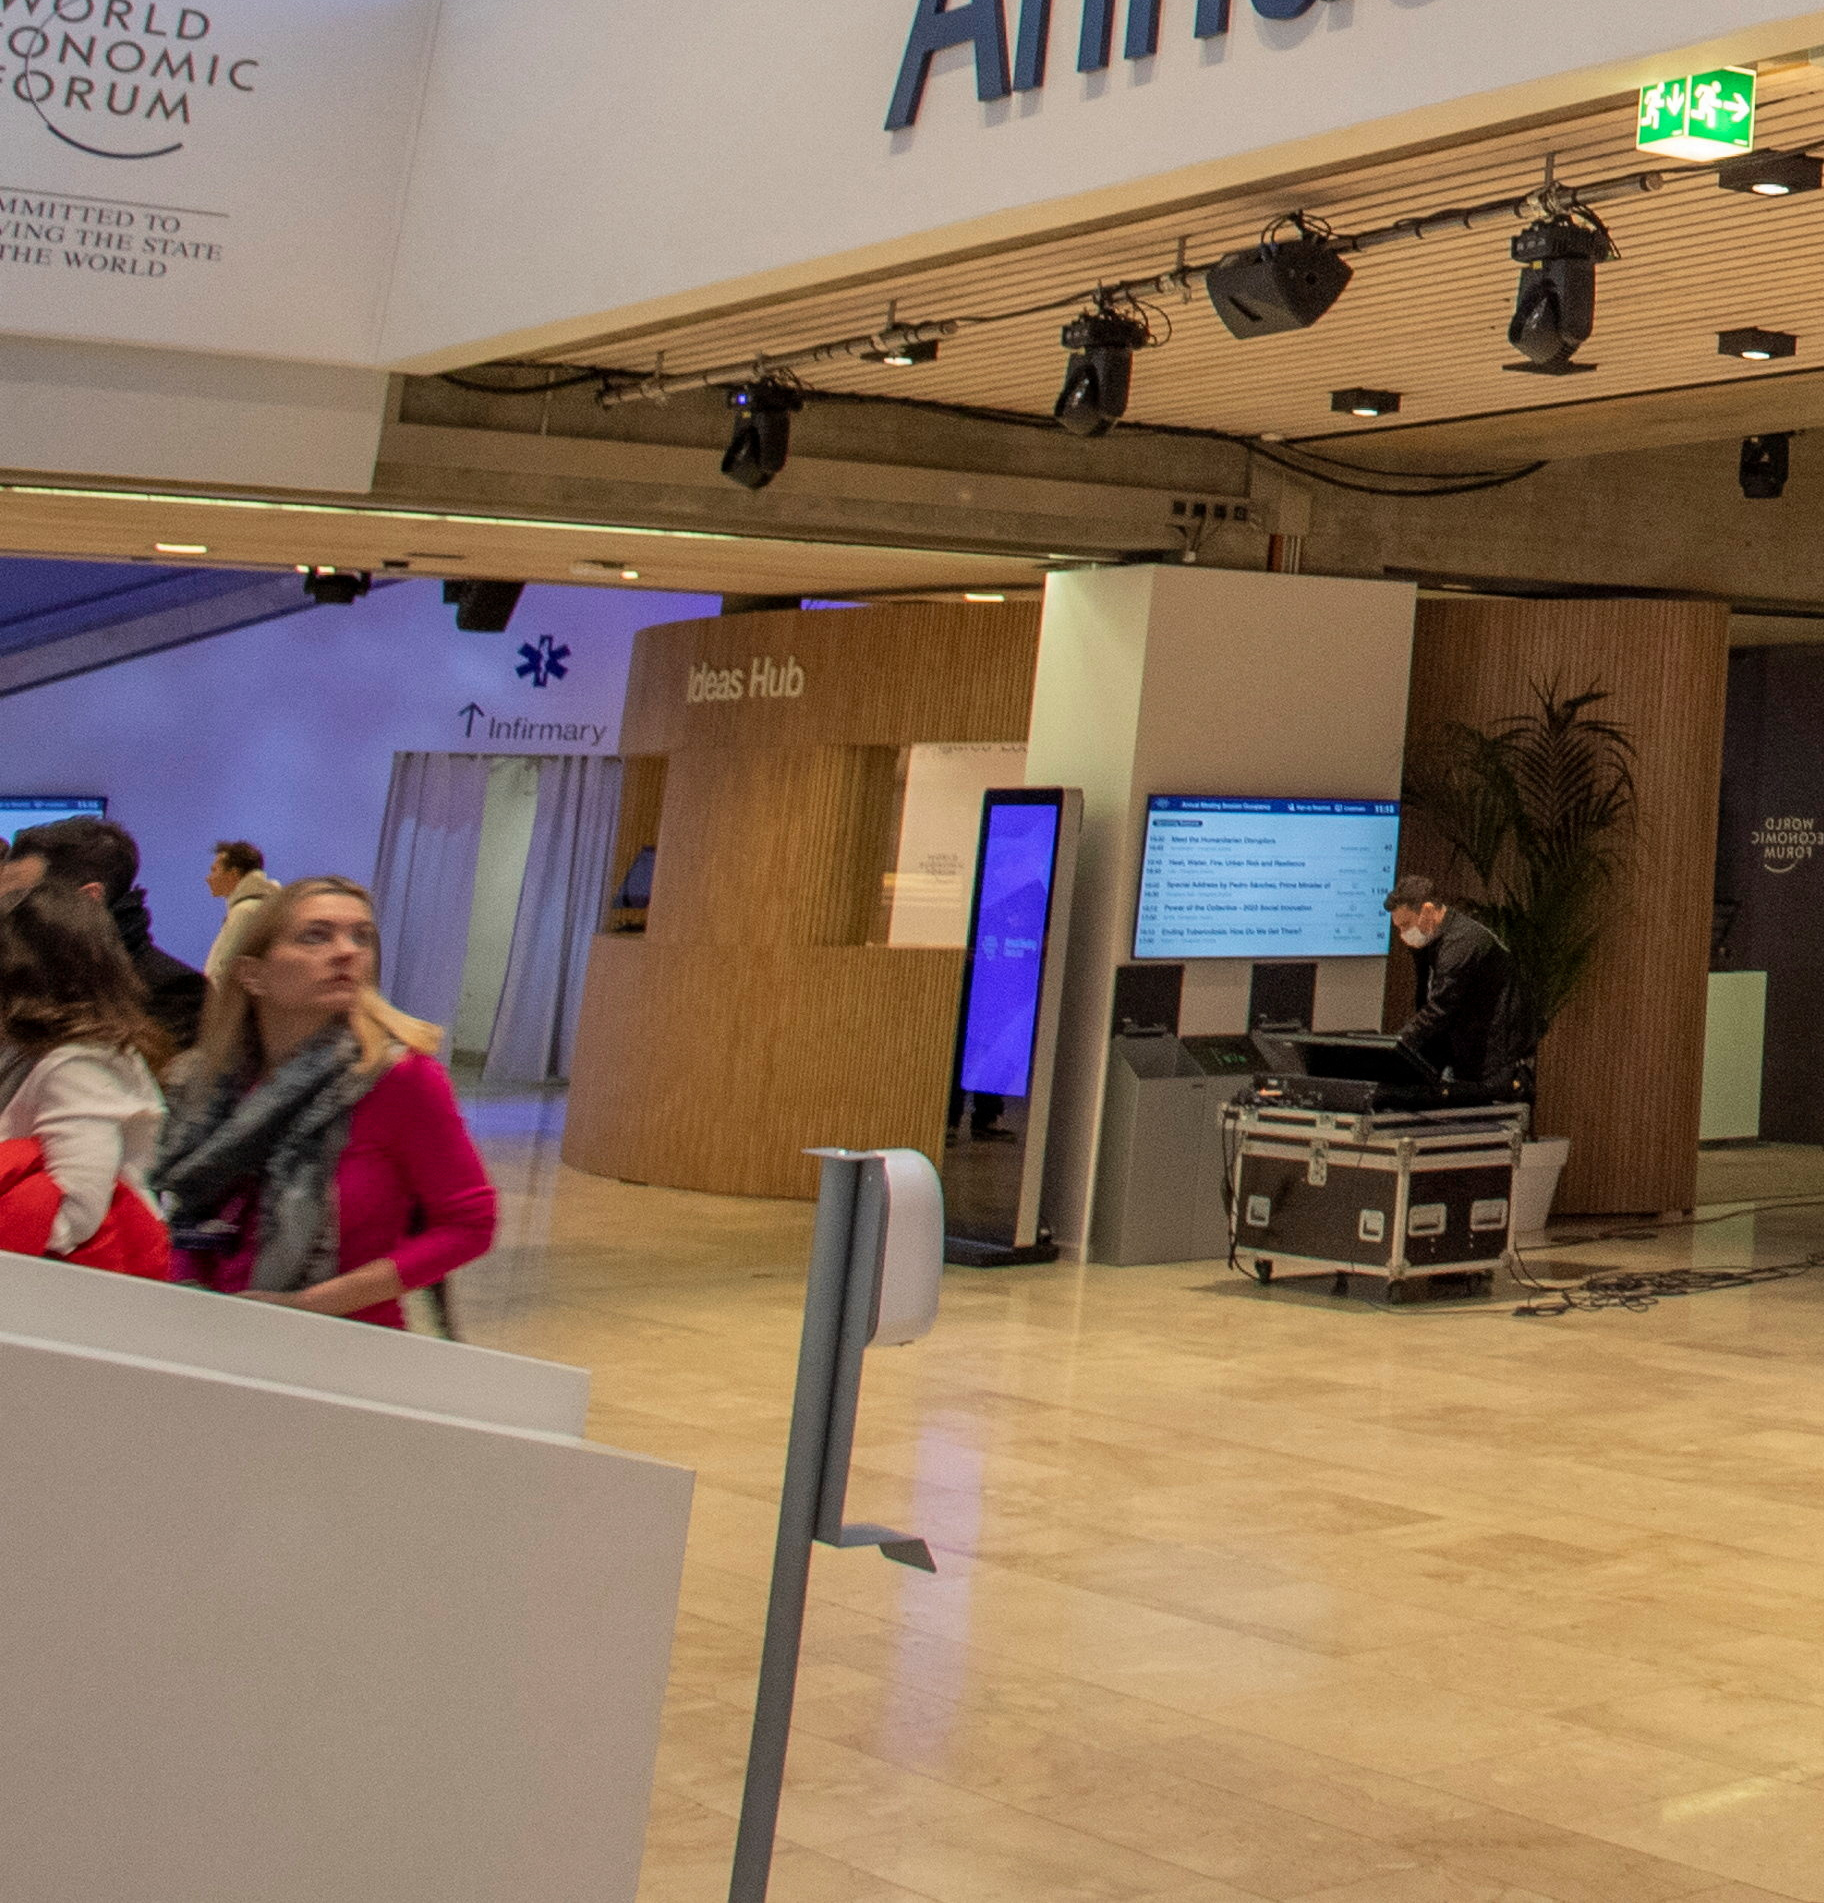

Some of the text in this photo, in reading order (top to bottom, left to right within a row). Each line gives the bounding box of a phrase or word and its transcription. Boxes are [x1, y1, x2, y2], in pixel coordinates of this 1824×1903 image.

[0, 65, 191, 124] ORUM
[143, 213, 182, 235] TO
[75, 228, 133, 253] THE
[141, 236, 223, 262] STATE
[63, 249, 169, 278] WORLD
[686, 654, 805, 704] Ideas Hub
[489, 716, 608, 747] Infirmary
